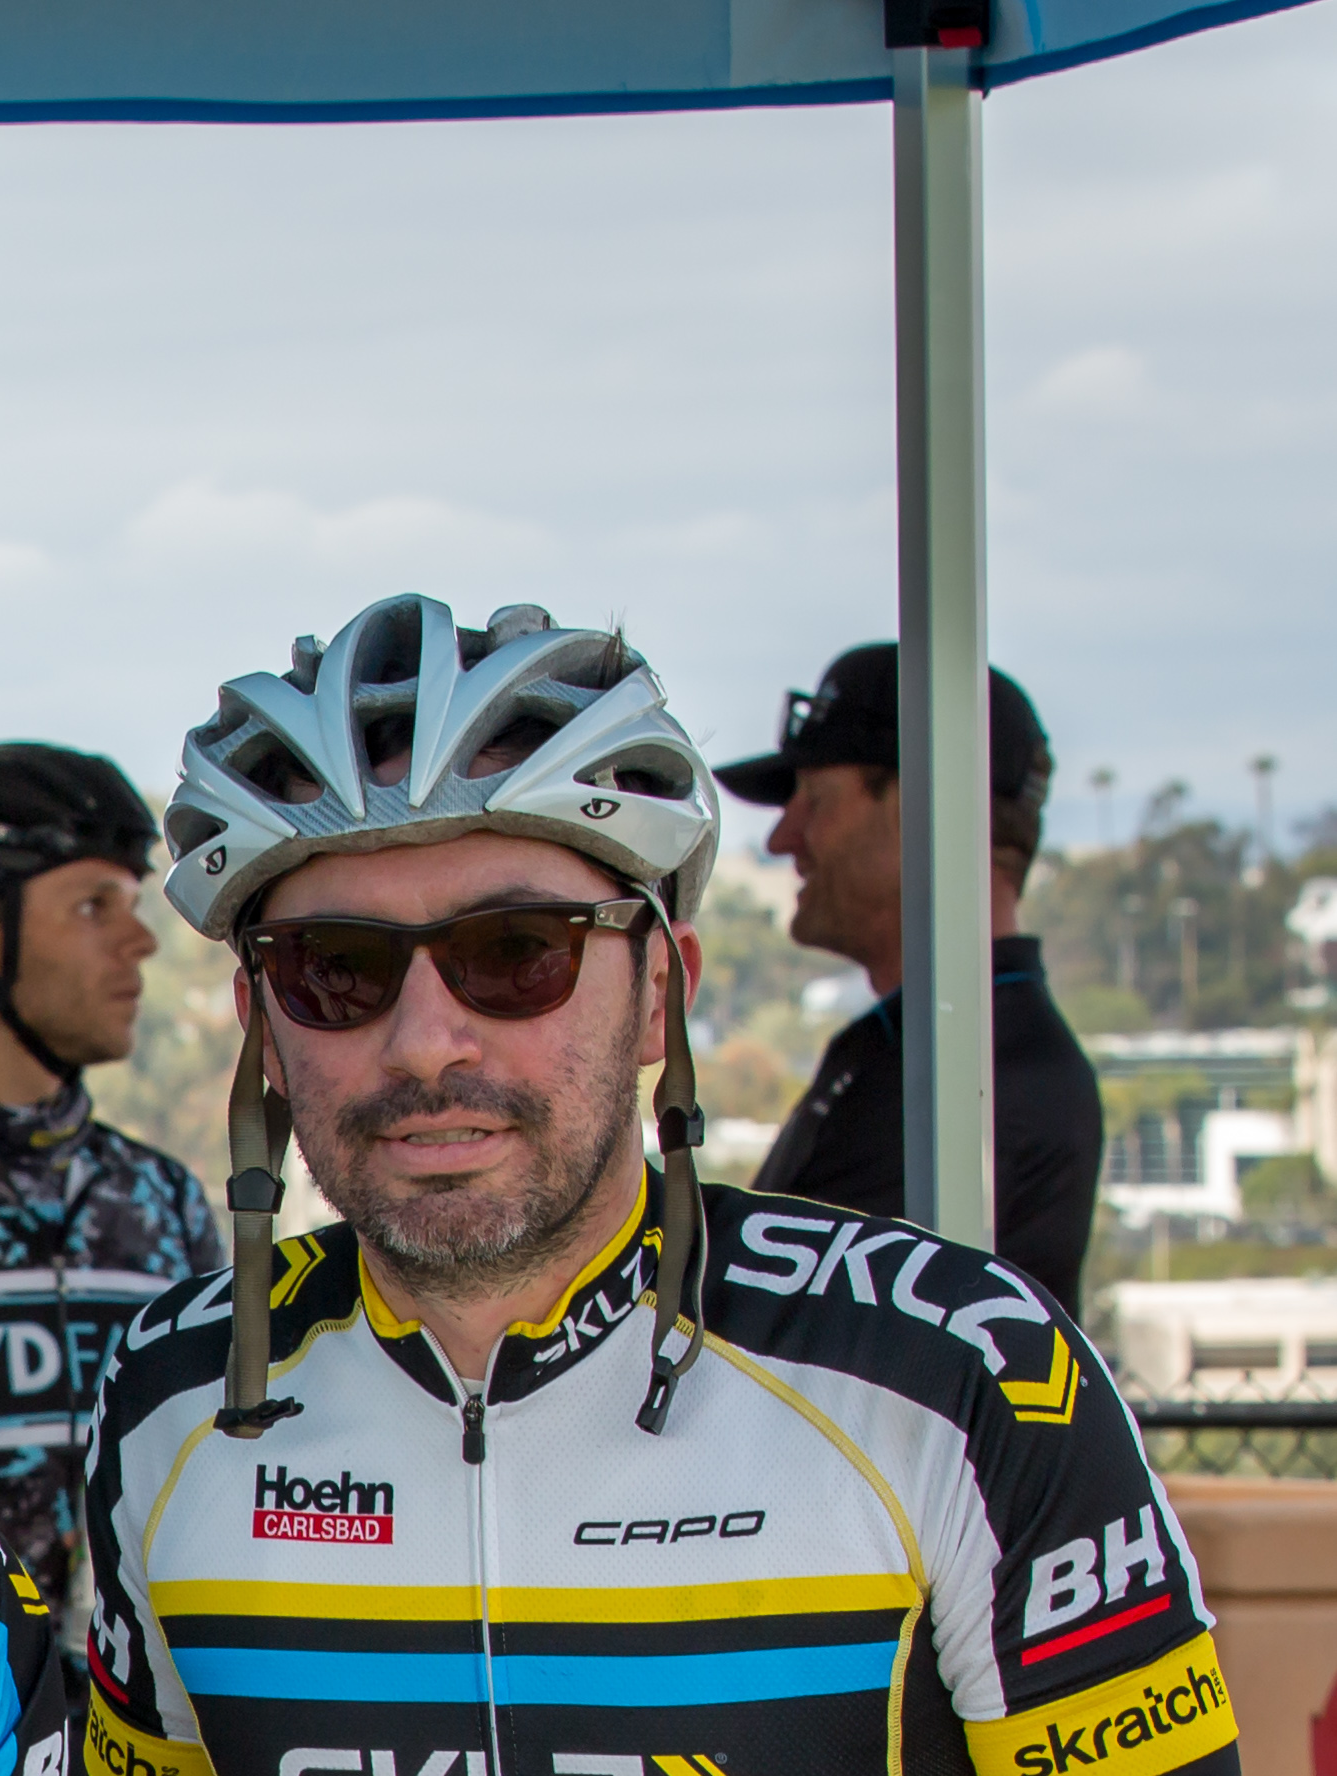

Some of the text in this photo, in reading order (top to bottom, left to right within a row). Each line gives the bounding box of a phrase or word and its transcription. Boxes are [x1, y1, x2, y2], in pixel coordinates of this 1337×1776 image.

[533, 1246, 653, 1376] SKLZ
[725, 1212, 1052, 1376] SKLZ
[256, 1464, 394, 1516] Hoehn
[264, 1515, 381, 1542] CARLSBAD
[573, 1510, 766, 1546] CAPO
[1023, 1504, 1167, 1639] BH
